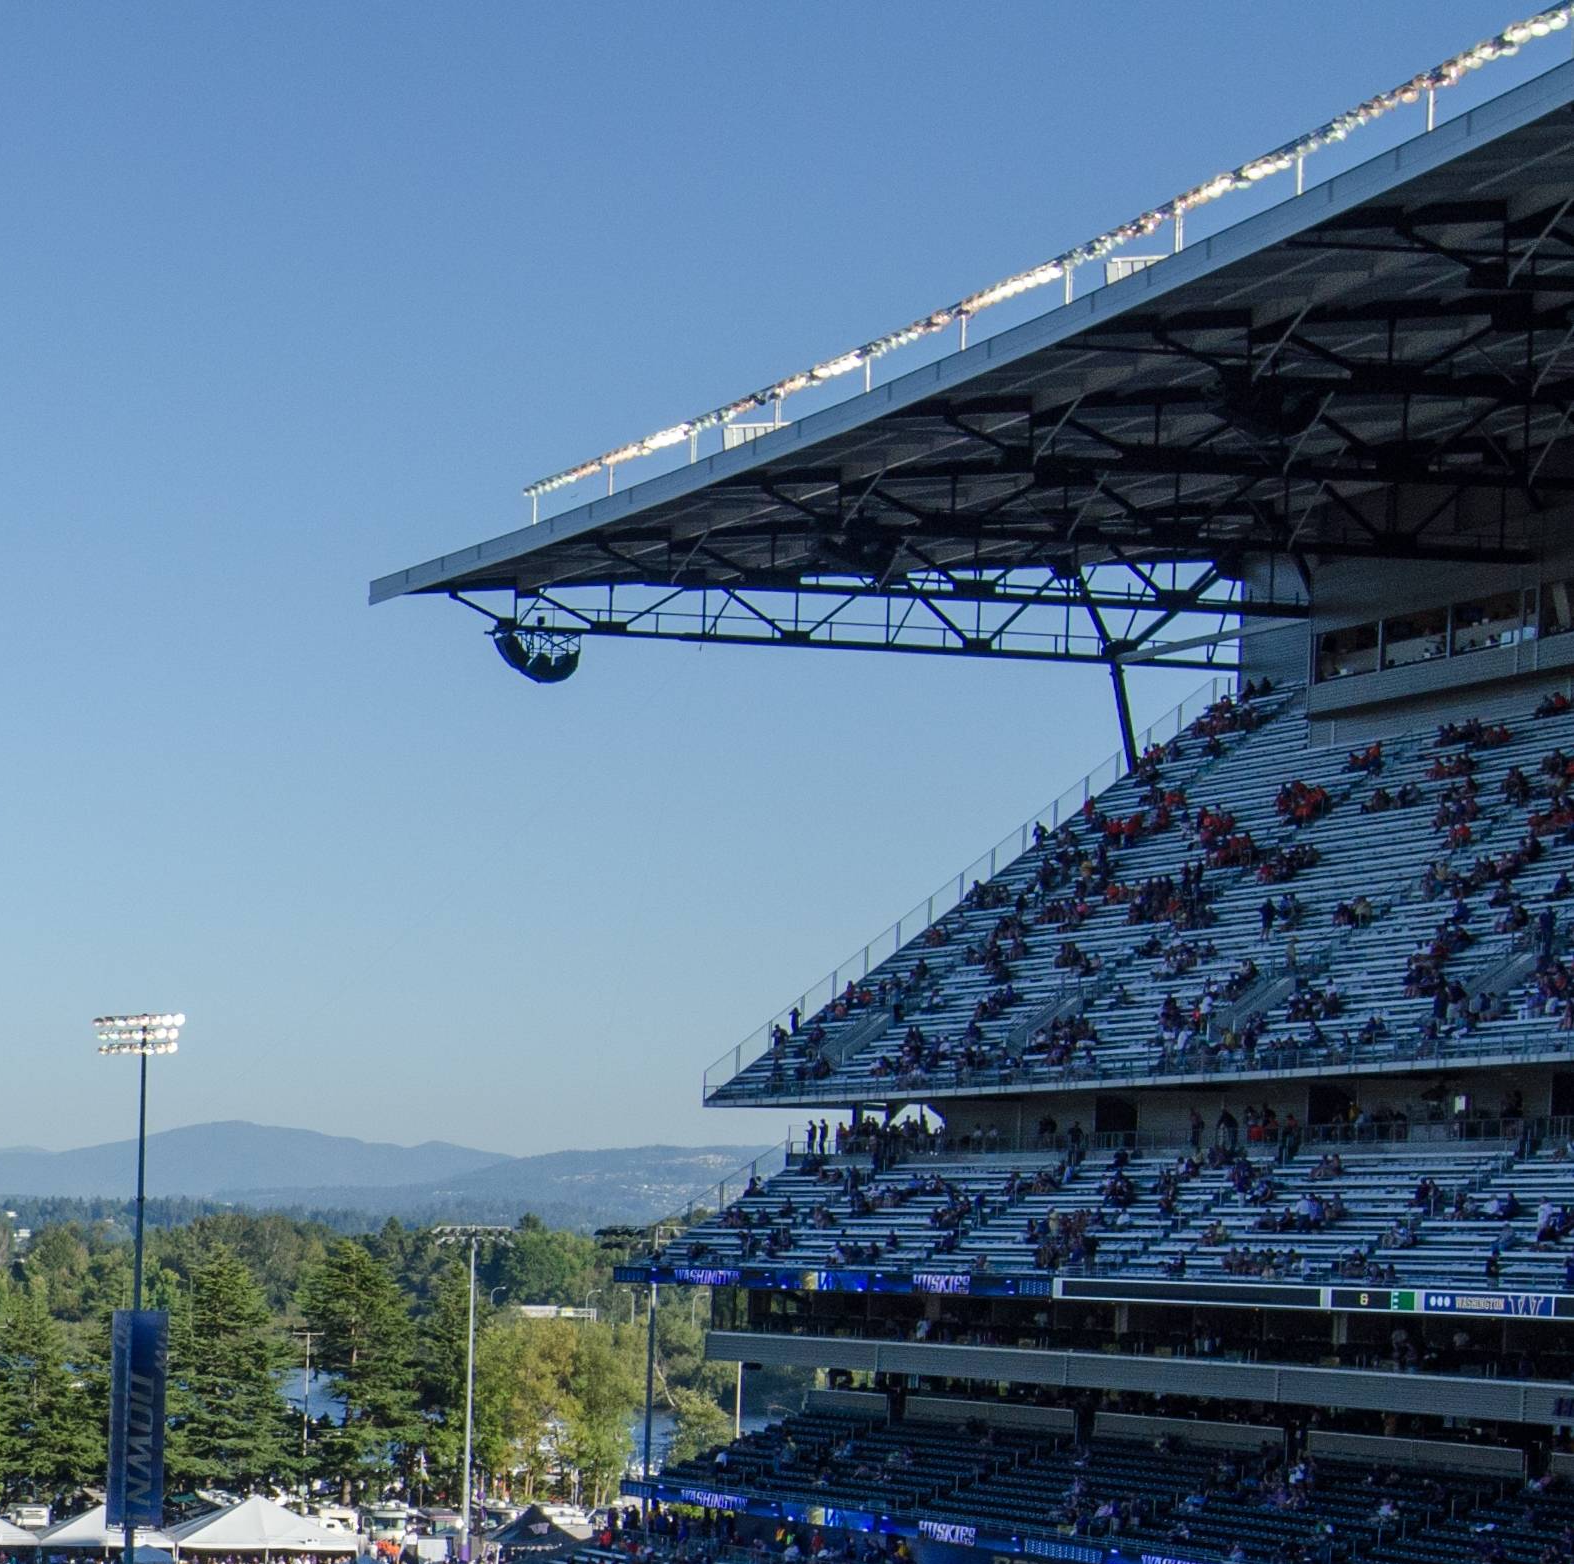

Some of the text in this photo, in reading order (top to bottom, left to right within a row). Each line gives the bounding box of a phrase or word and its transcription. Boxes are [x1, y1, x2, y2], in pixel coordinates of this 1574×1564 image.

[675, 1269, 740, 1285] WASHINGTON
[913, 1273, 971, 1295] HUSKIES
[1455, 1296, 1505, 1310] WASHINGTON
[1508, 1294, 1545, 1316] W
[680, 1489, 747, 1512] WASHINGTON
[918, 1519, 976, 1546] HUSKIES
